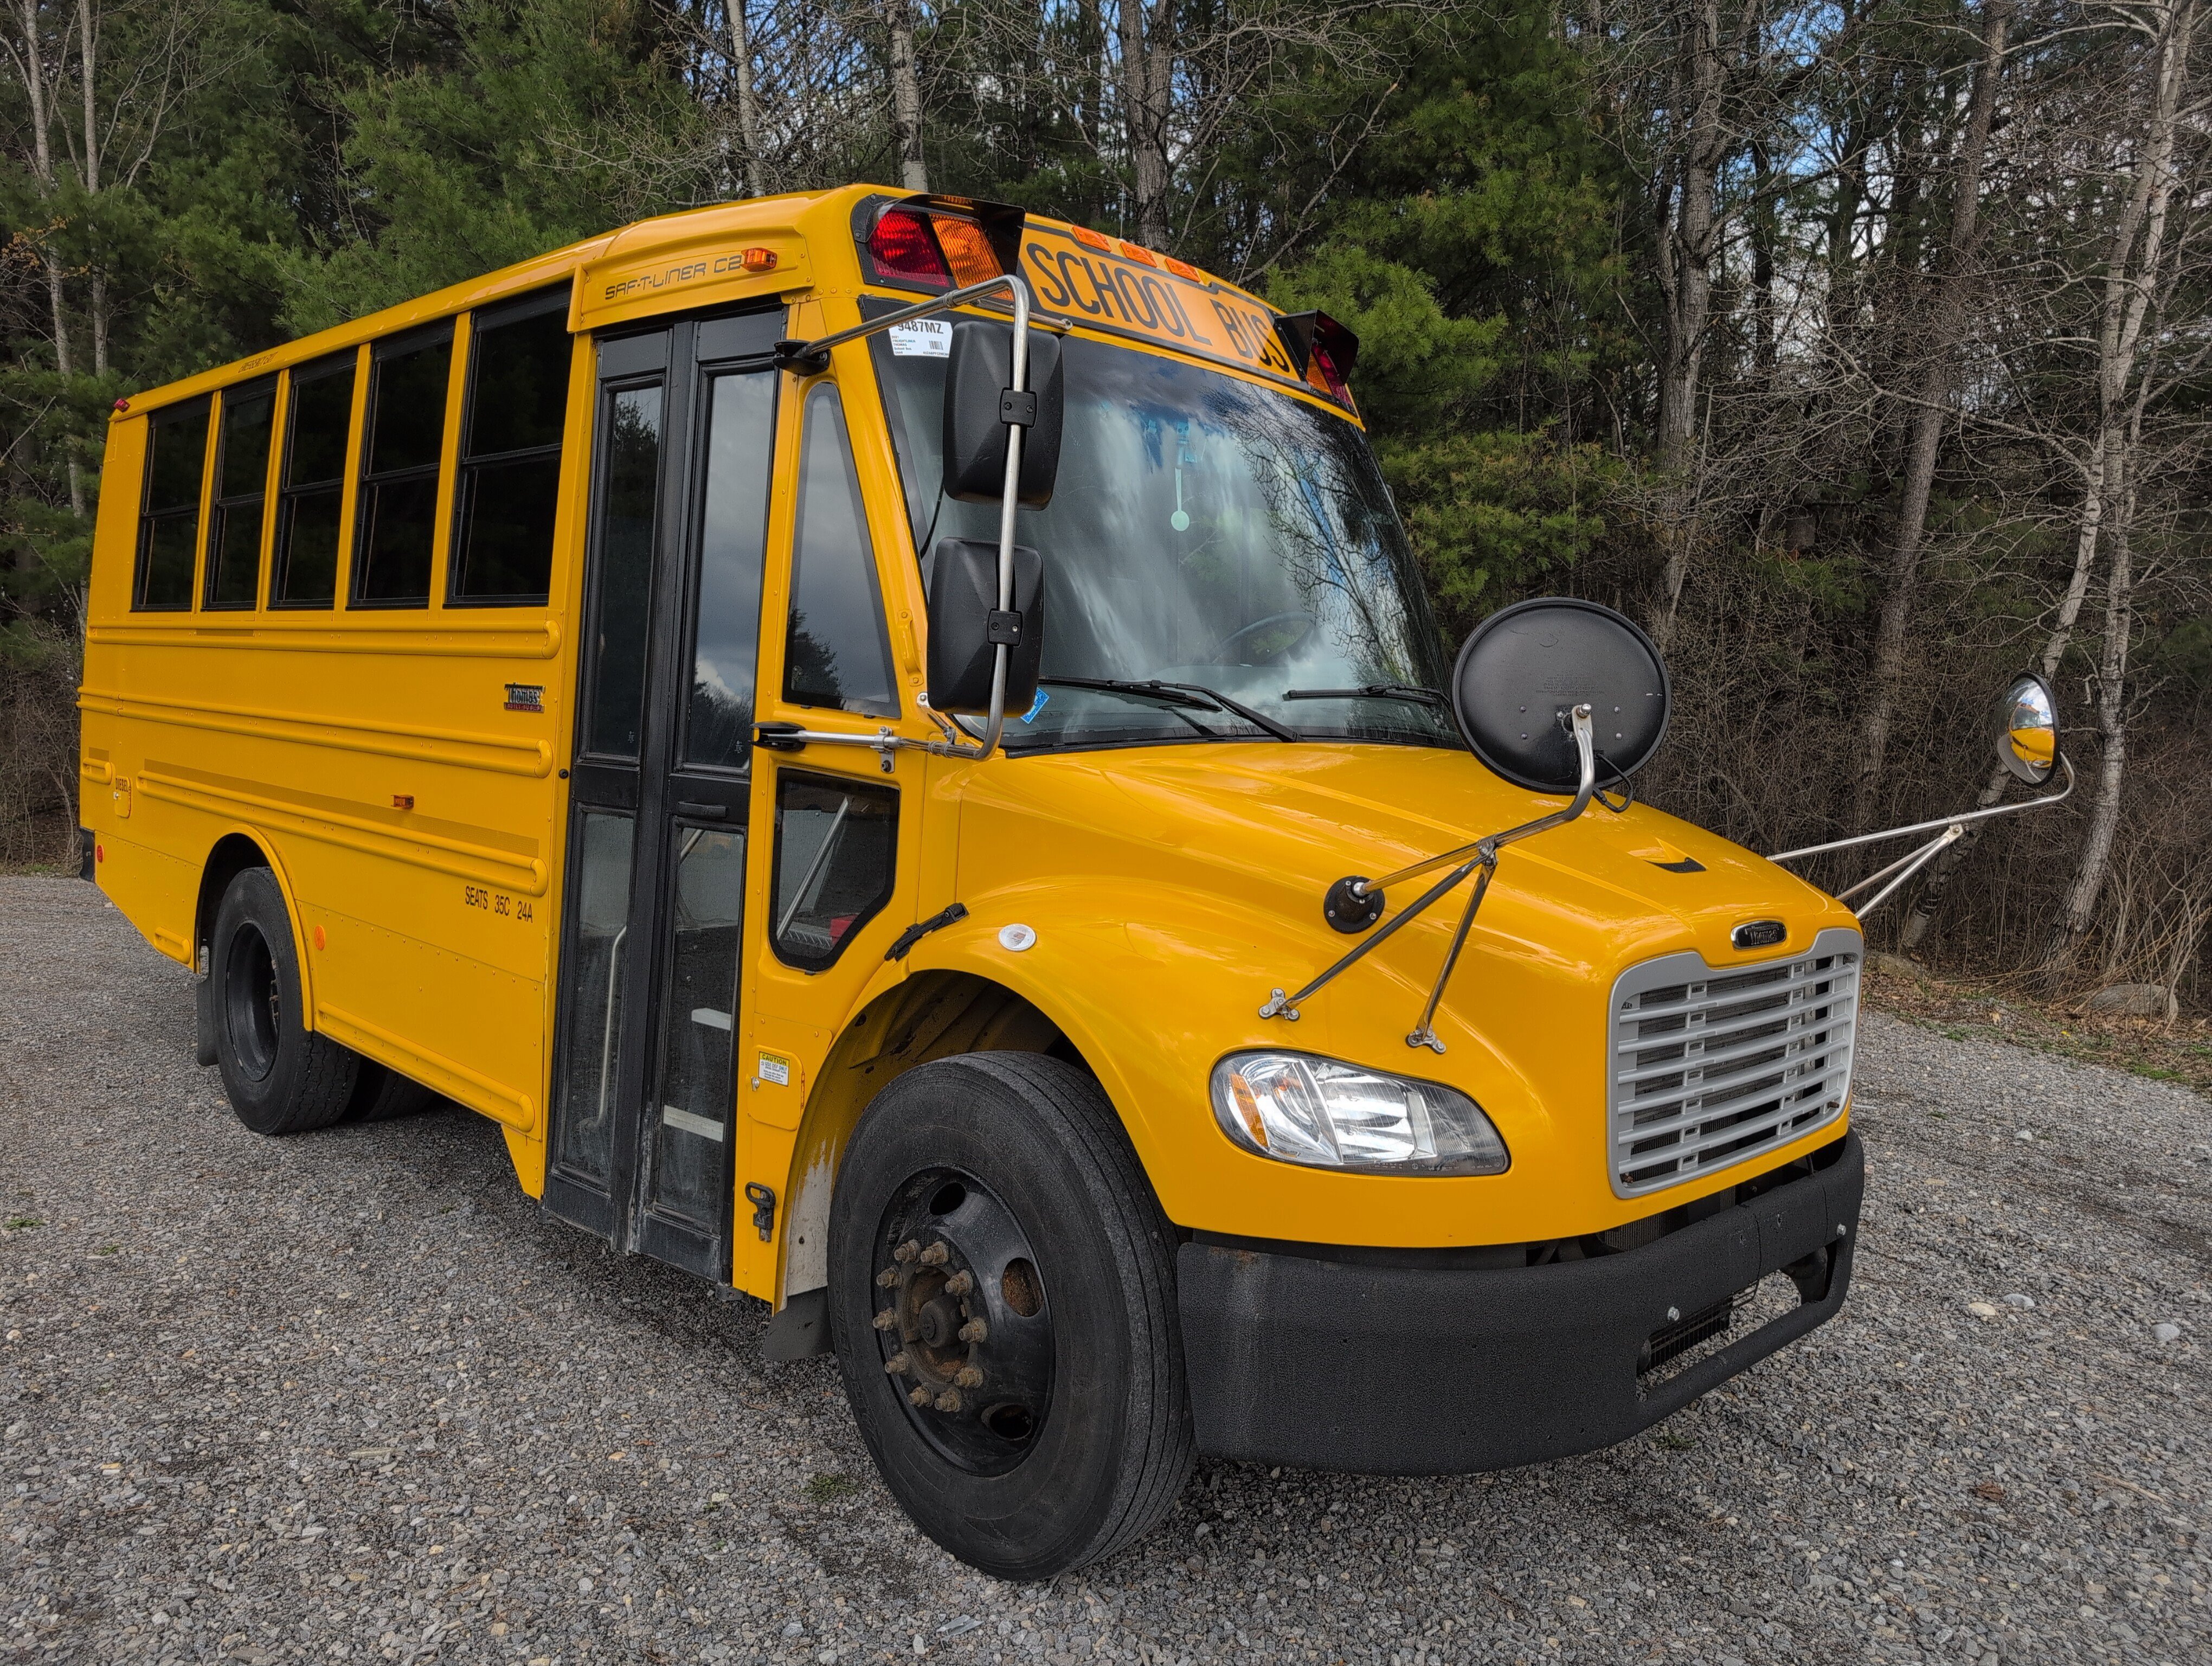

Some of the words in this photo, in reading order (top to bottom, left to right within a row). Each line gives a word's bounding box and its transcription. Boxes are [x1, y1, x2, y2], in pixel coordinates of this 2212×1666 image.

[713, 255, 742, 273] C2
[1026, 242, 1213, 347] SCHOOL
[1210, 298, 1290, 373] BUS
[115, 778, 128, 792] DIESEL
[465, 885, 488, 910] SEATS
[494, 894, 510, 917] 35C
[517, 900, 533, 924] 24A
[762, 1054, 787, 1065] CAUTION
